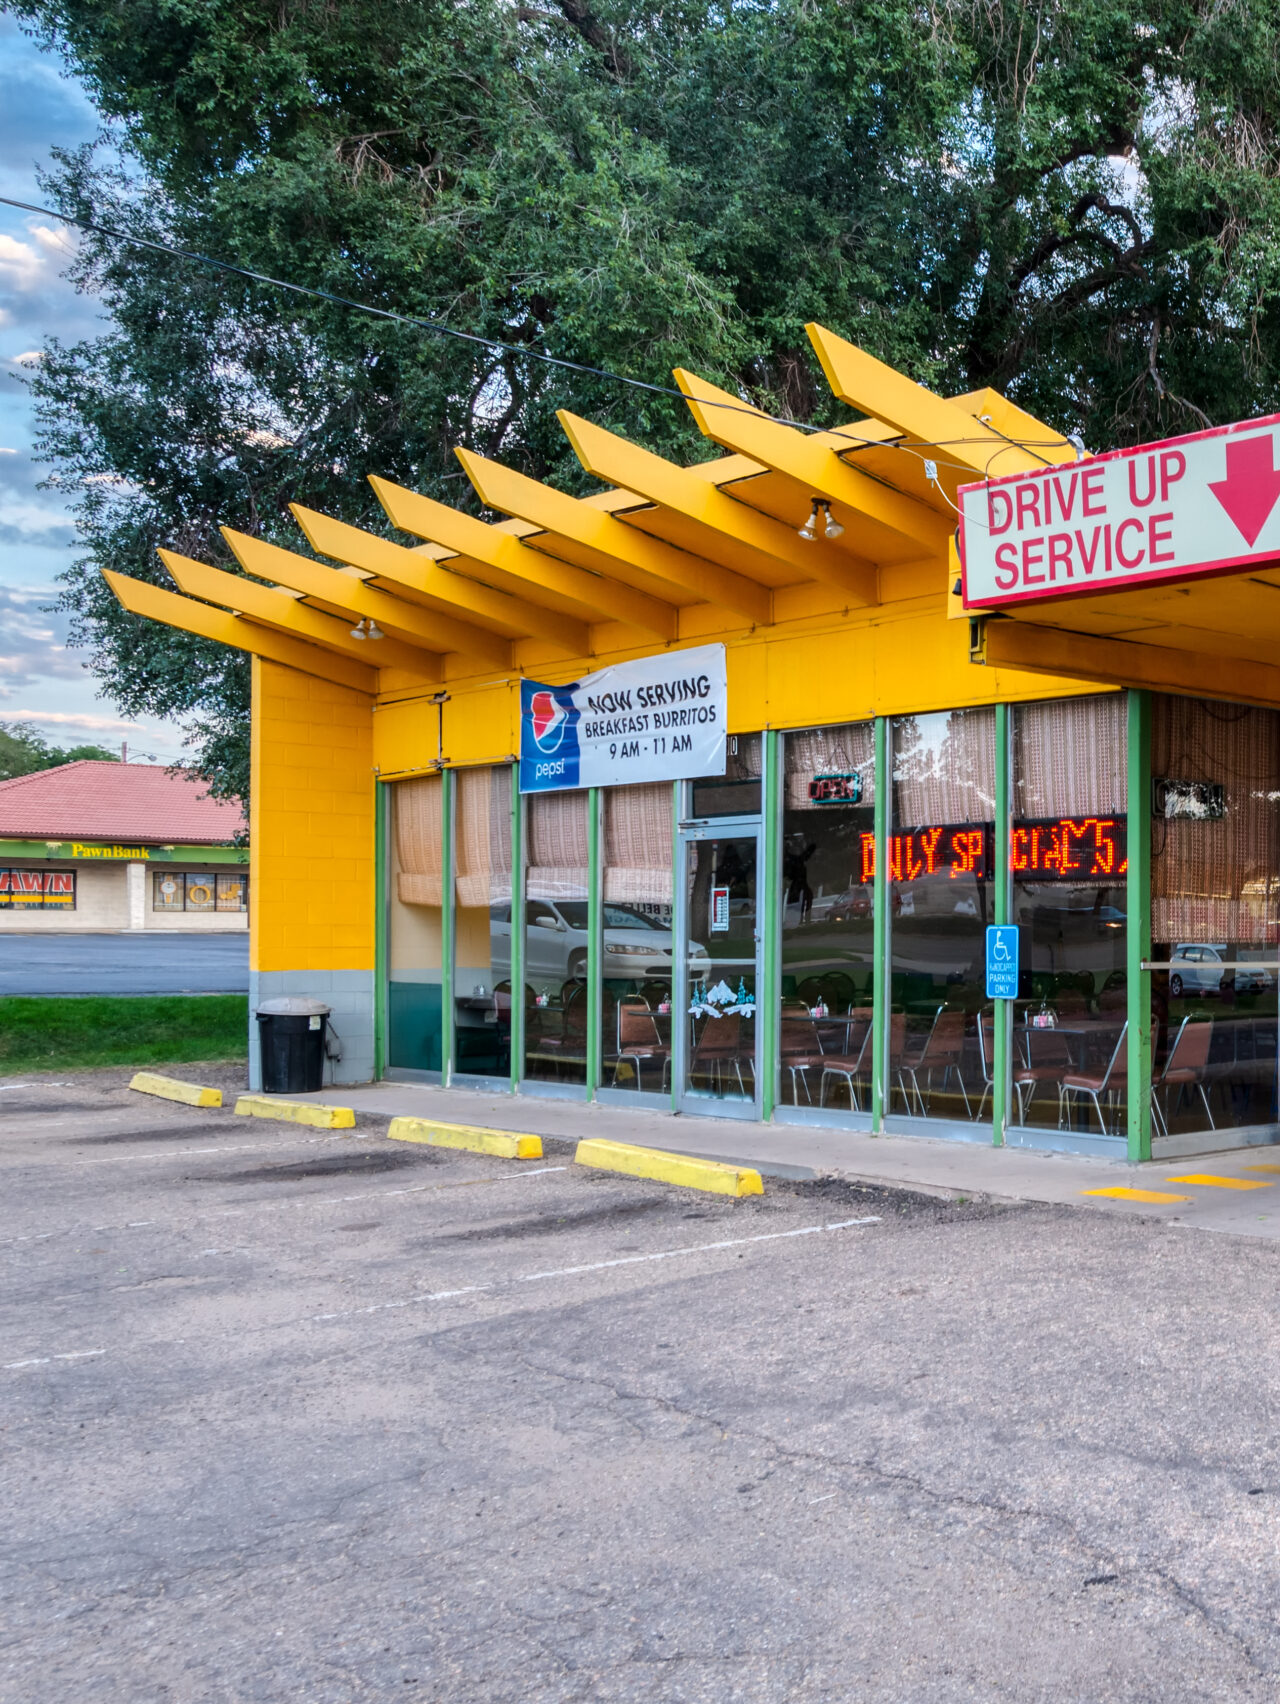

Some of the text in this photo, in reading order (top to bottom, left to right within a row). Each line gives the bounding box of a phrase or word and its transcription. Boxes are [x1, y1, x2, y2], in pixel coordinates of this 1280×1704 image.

[988, 450, 1187, 536] DRIVE UP
[994, 512, 1175, 590] SERVICE
[588, 675, 711, 715] NOW SERVING
[585, 705, 716, 738] BREAKFAST BURRITOS
[609, 743, 616, 760] 9
[620, 741, 640, 758] AM
[653, 737, 666, 755] 11
[672, 734, 692, 752] AM
[535, 758, 566, 780] pepsi
[807, 778, 855, 799] OPEN
[72, 843, 150, 859] PawnBank
[990, 973, 1016, 983] PARKING
[995, 984, 1010, 993] ONLY
